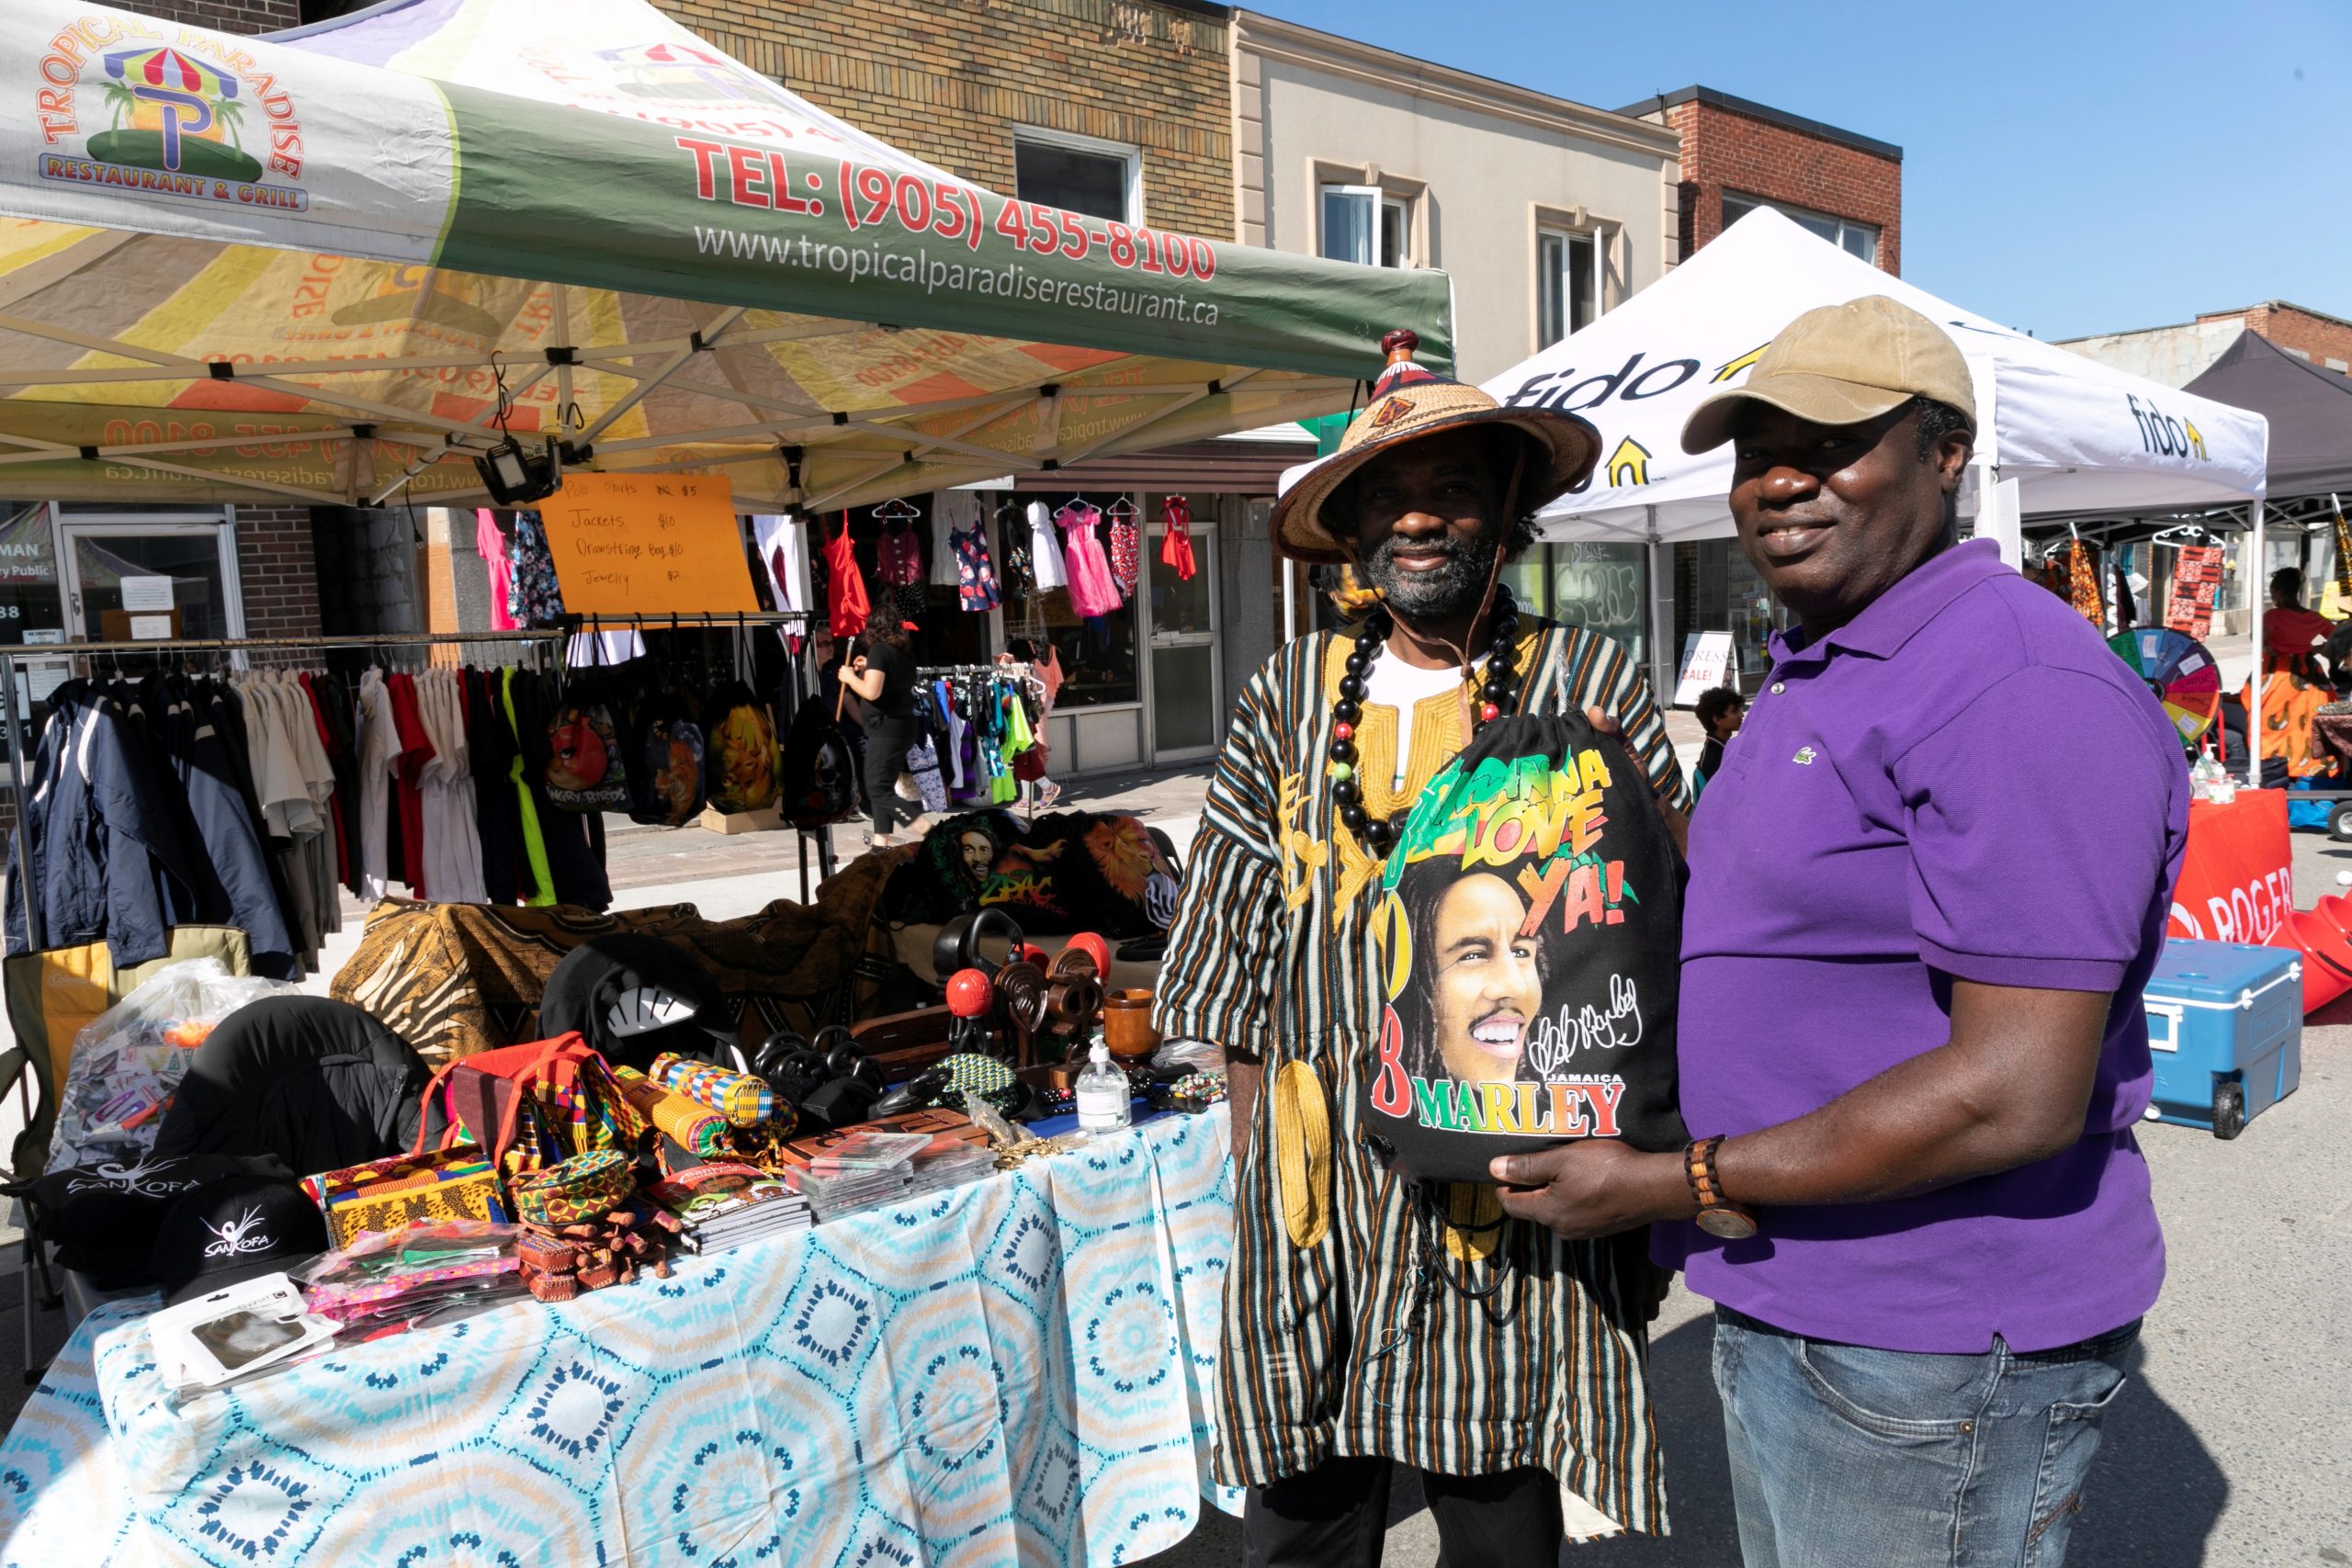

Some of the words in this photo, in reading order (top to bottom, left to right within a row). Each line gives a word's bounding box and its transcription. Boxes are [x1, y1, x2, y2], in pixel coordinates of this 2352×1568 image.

[36, 16, 163, 144] TROPICAL
[176, 28, 303, 180] PARADISE
[48, 159, 207, 196] RESTAURANT
[213, 183, 229, 199] &
[238, 186, 299, 208] GRILL
[674, 136, 824, 217] TEL:
[839, 160, 983, 252] (905)
[996, 198, 1216, 281] 455-8100
[695, 226, 1218, 325] www.tropicalparadiserestaurant.ca
[1504, 352, 1701, 412] fido
[2126, 393, 2188, 458] fido
[682, 485, 697, 497] $5
[568, 509, 625, 528] Jackets
[659, 513, 675, 529] $10
[576, 537, 642, 559] Drawstring
[12, 565, 49, 577] Public
[582, 570, 629, 597] Jewelry
[1682, 669, 1712, 681] SALE!
[585, 787, 627, 801] BIRDS
[1462, 788, 1604, 871] LOVE
[1517, 857, 1625, 938] YA!
[1547, 1073, 1623, 1083] JAMAICA
[1412, 1077, 1625, 1137] MARLEY
[67, 1179, 202, 1198] SANKOFA
[204, 1235, 277, 1258] SANKOFA
